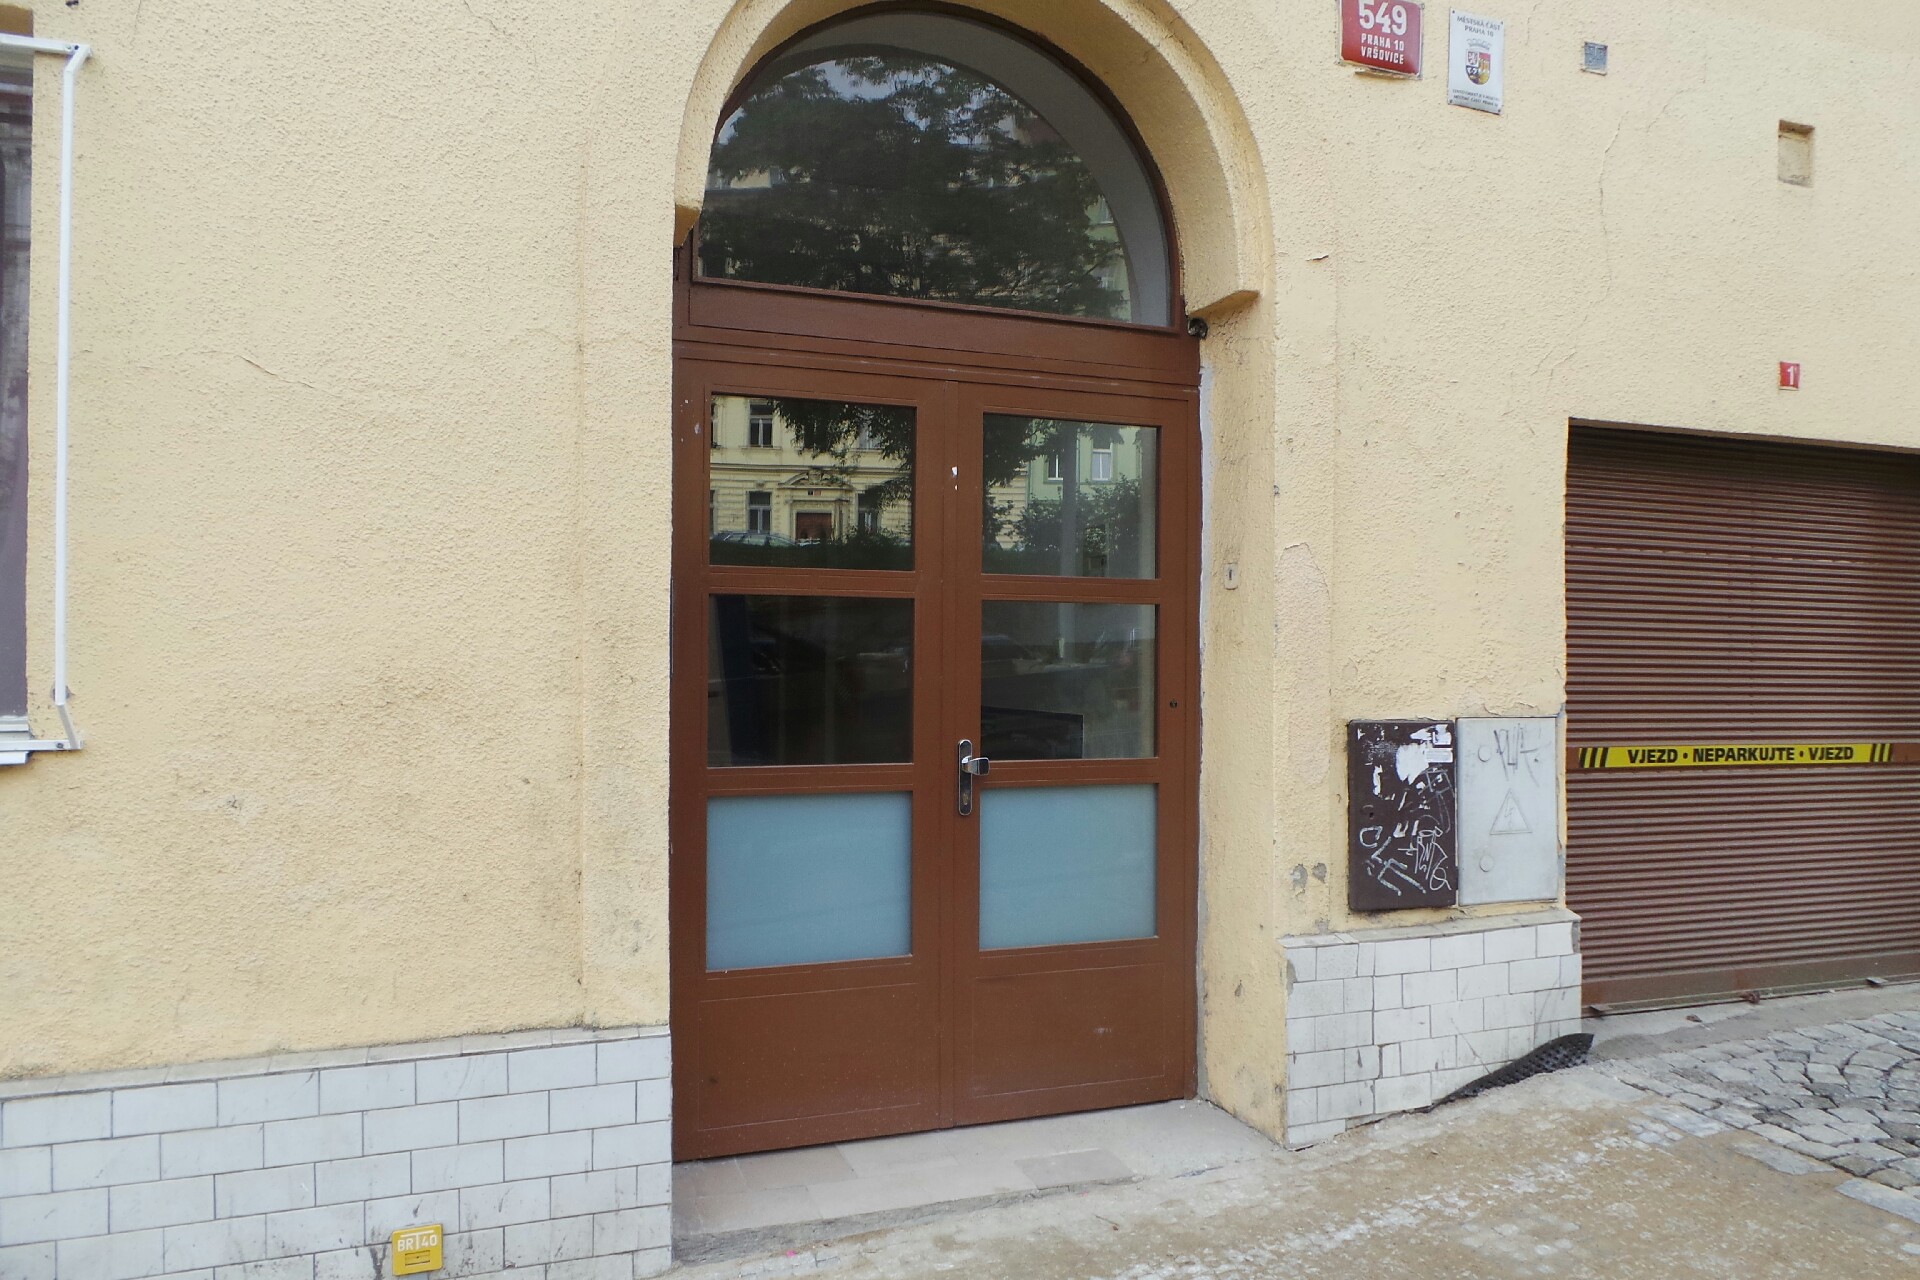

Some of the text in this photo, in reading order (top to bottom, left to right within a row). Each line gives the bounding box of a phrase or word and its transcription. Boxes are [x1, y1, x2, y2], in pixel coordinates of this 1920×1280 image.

[1358, 0, 1407, 36] 549
[1464, 25, 1494, 37] PRAHA 10
[1361, 33, 1404, 51] PRAHA 10
[1361, 46, 1404, 65] VRŠOVICE
[1787, 365, 1794, 386] 1
[1627, 746, 1854, 764] VJEZD NEPARKUJTE VJEZD
